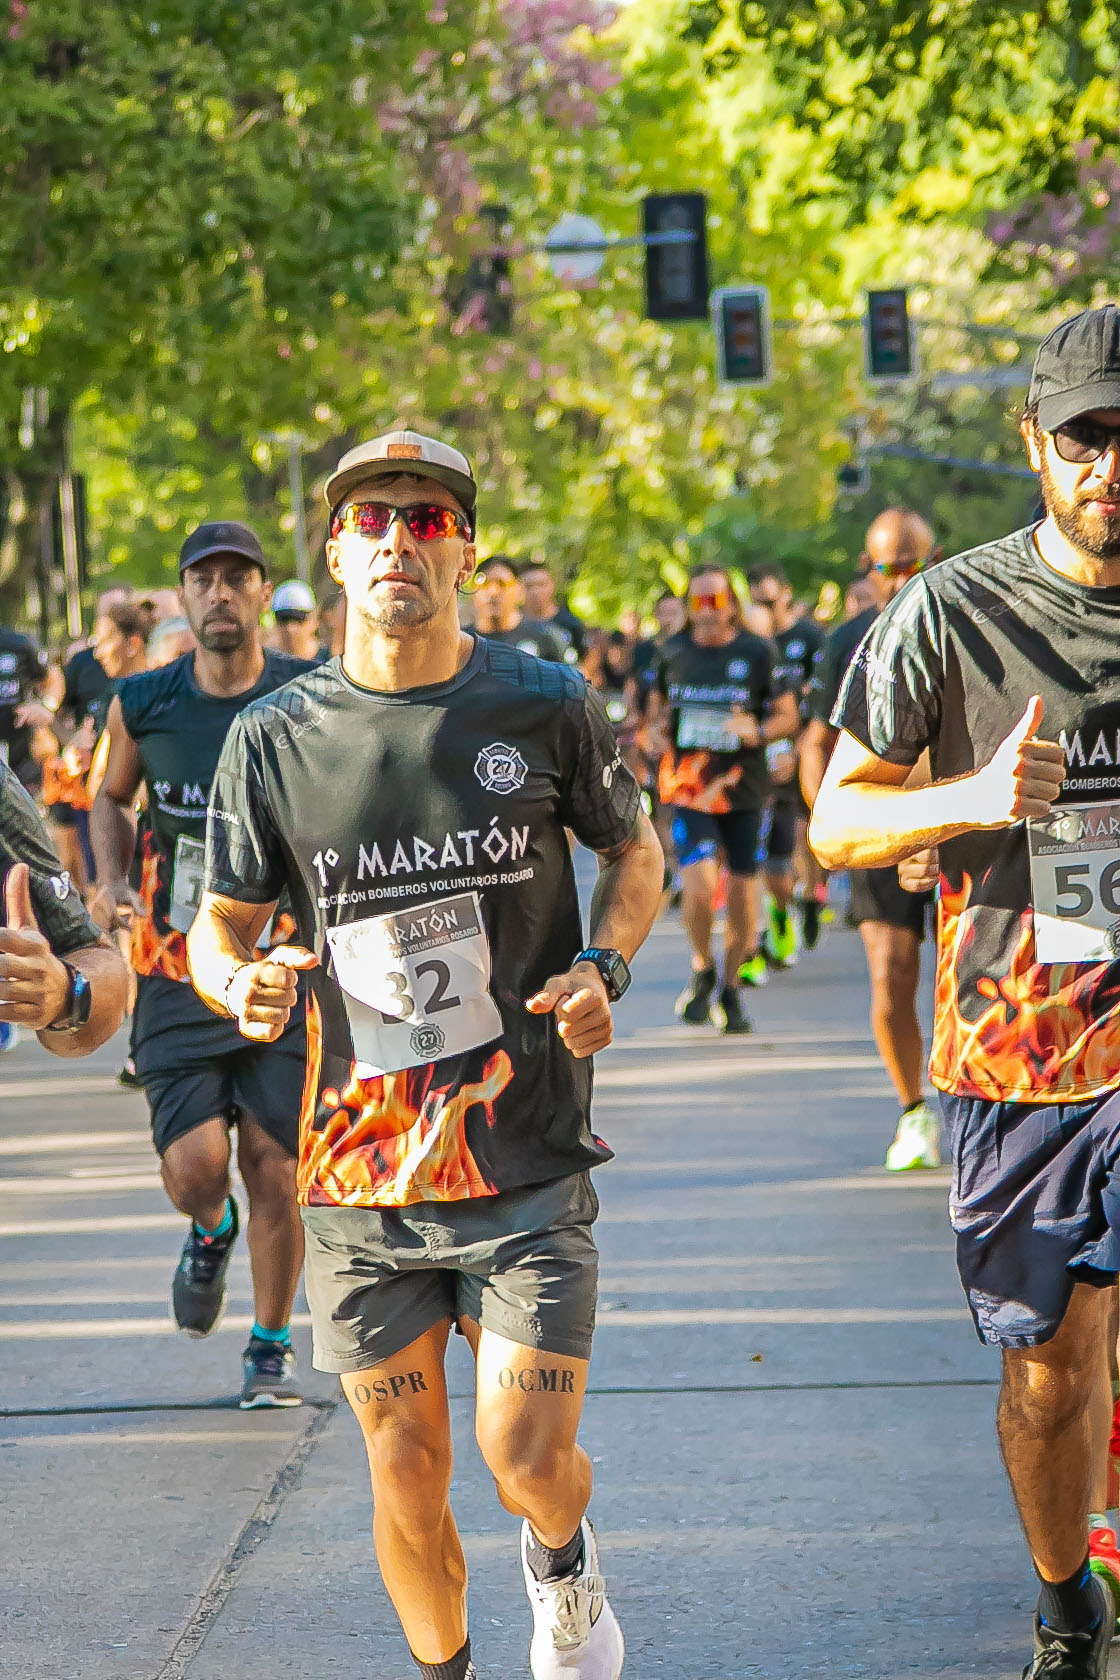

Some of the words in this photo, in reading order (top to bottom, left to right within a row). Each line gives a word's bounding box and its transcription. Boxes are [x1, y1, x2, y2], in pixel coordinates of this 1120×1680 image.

[1059, 729, 1120, 768] MA
[312, 848, 340, 887] 1º
[357, 816, 529, 880] MARATÓN
[368, 883, 428, 900] BOMBEROS
[354, 1370, 429, 1405] OSPR
[498, 1367, 575, 1393] OCMR
